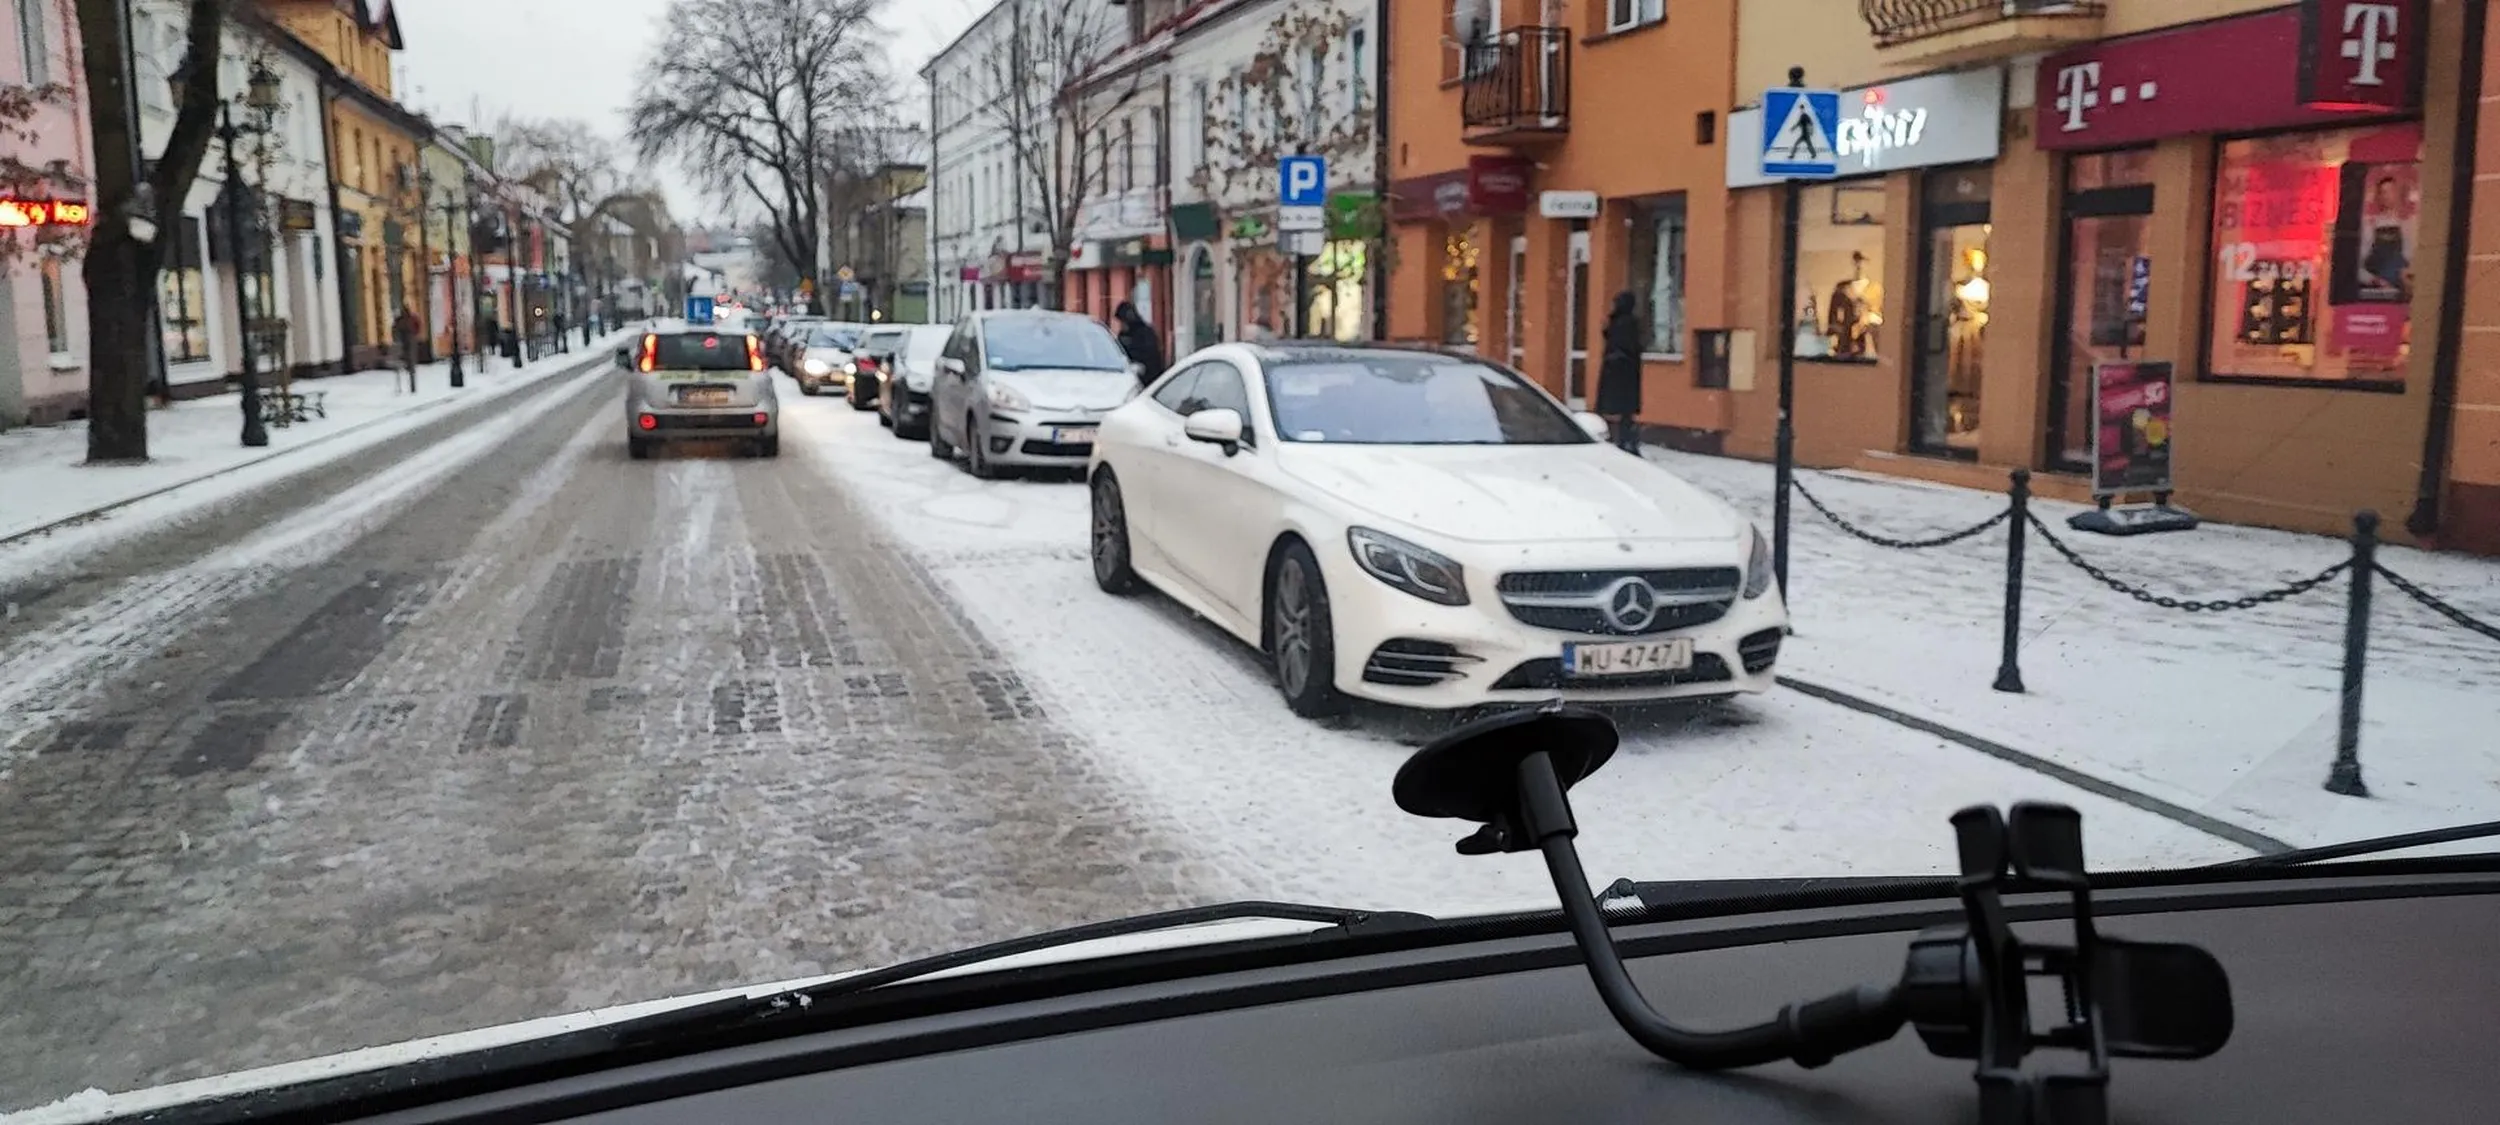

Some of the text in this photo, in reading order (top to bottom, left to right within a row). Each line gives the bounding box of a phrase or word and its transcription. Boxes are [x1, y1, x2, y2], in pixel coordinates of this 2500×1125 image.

[2341, 3, 2399, 85] T
[1290, 161, 1318, 200] P
[2219, 242, 2256, 281] 12
[1620, 641, 1684, 668] 4747J
